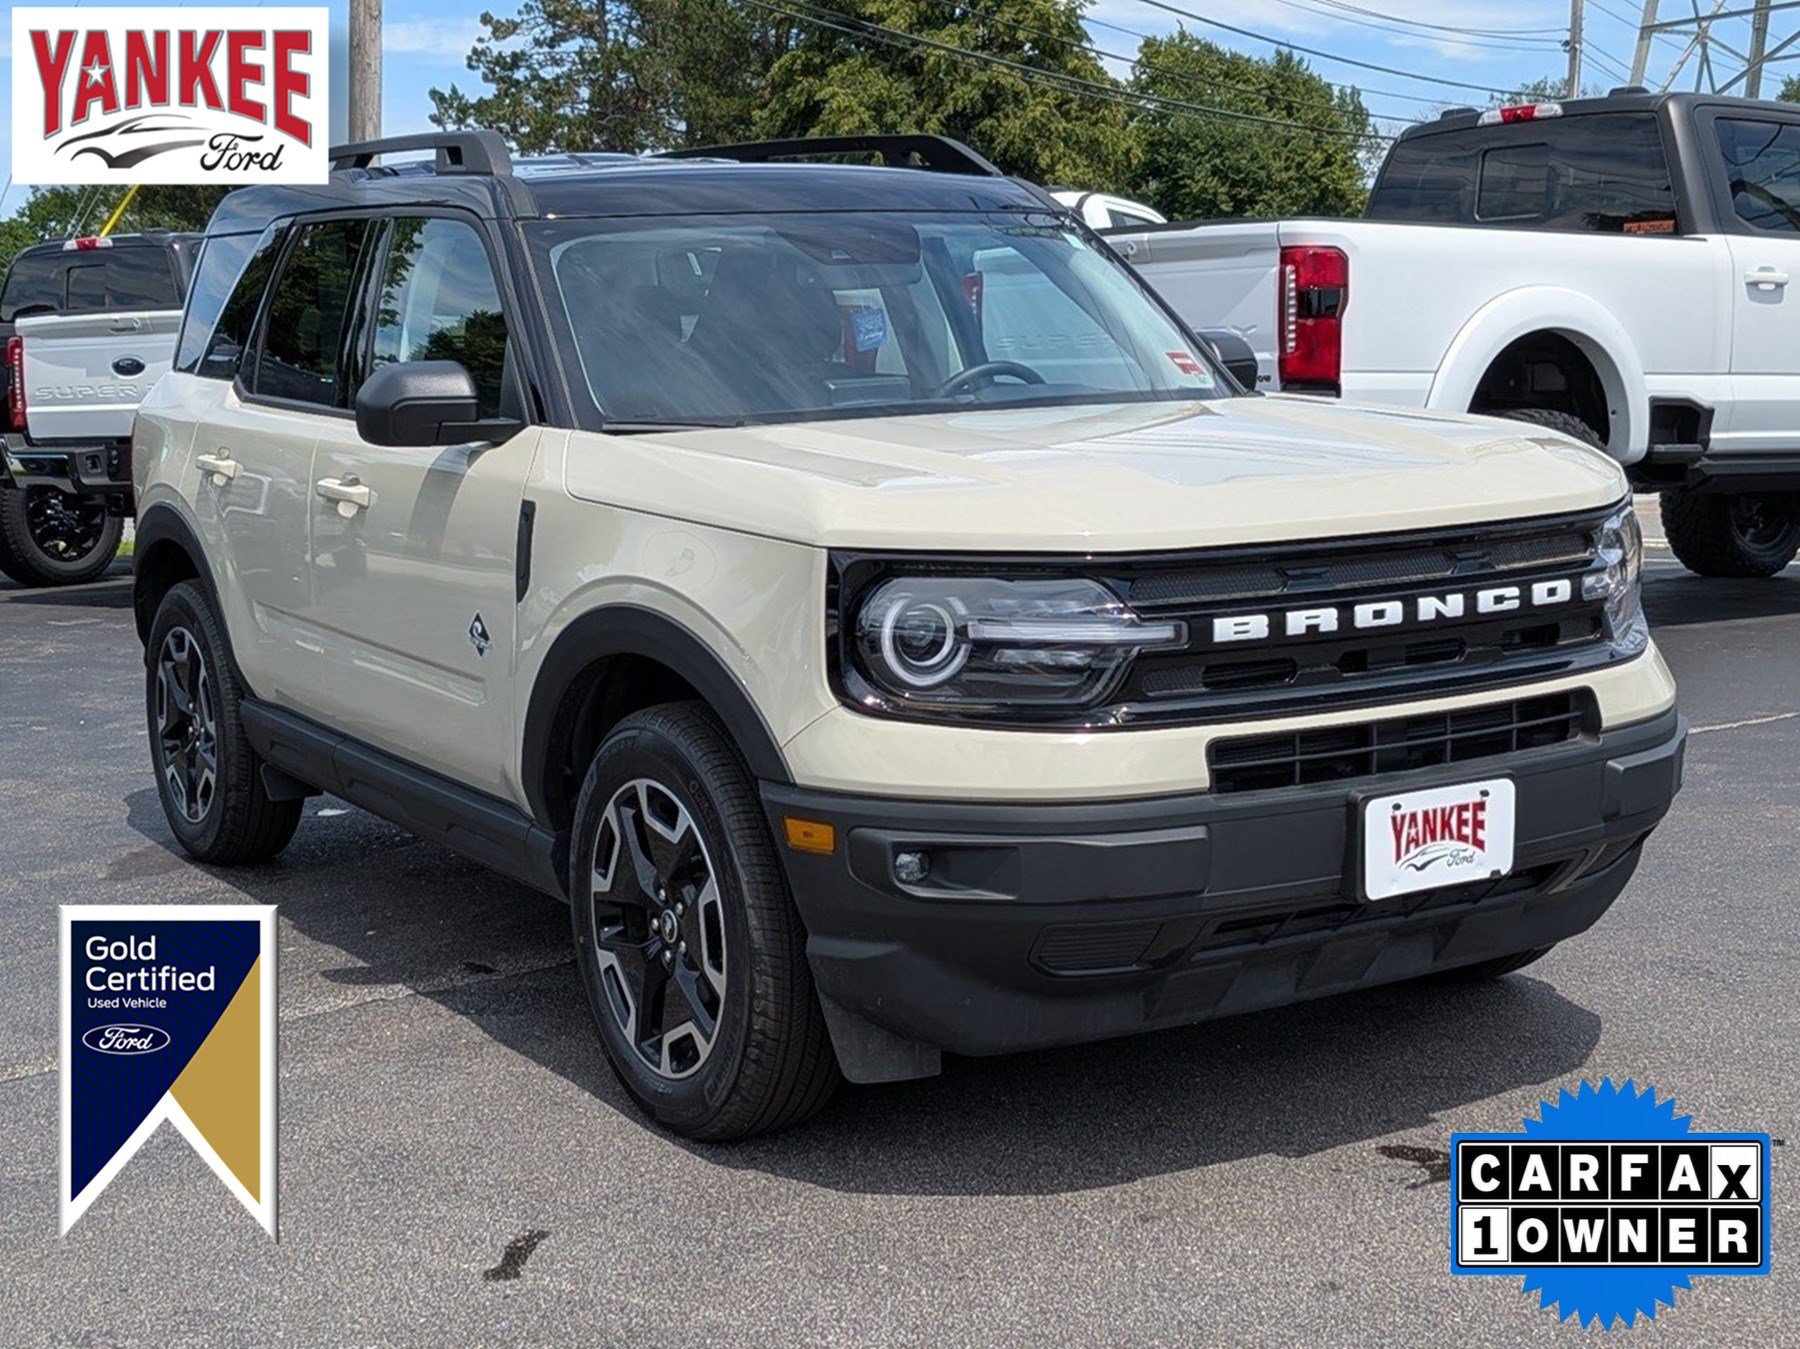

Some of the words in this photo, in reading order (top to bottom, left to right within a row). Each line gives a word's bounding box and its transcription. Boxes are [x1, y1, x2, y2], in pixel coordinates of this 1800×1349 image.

[35, 383, 138, 400] SUPER
[1213, 579, 1571, 642] BRONCO
[1390, 799, 1487, 864] YANKEE
[1447, 848, 1476, 867] Ford
